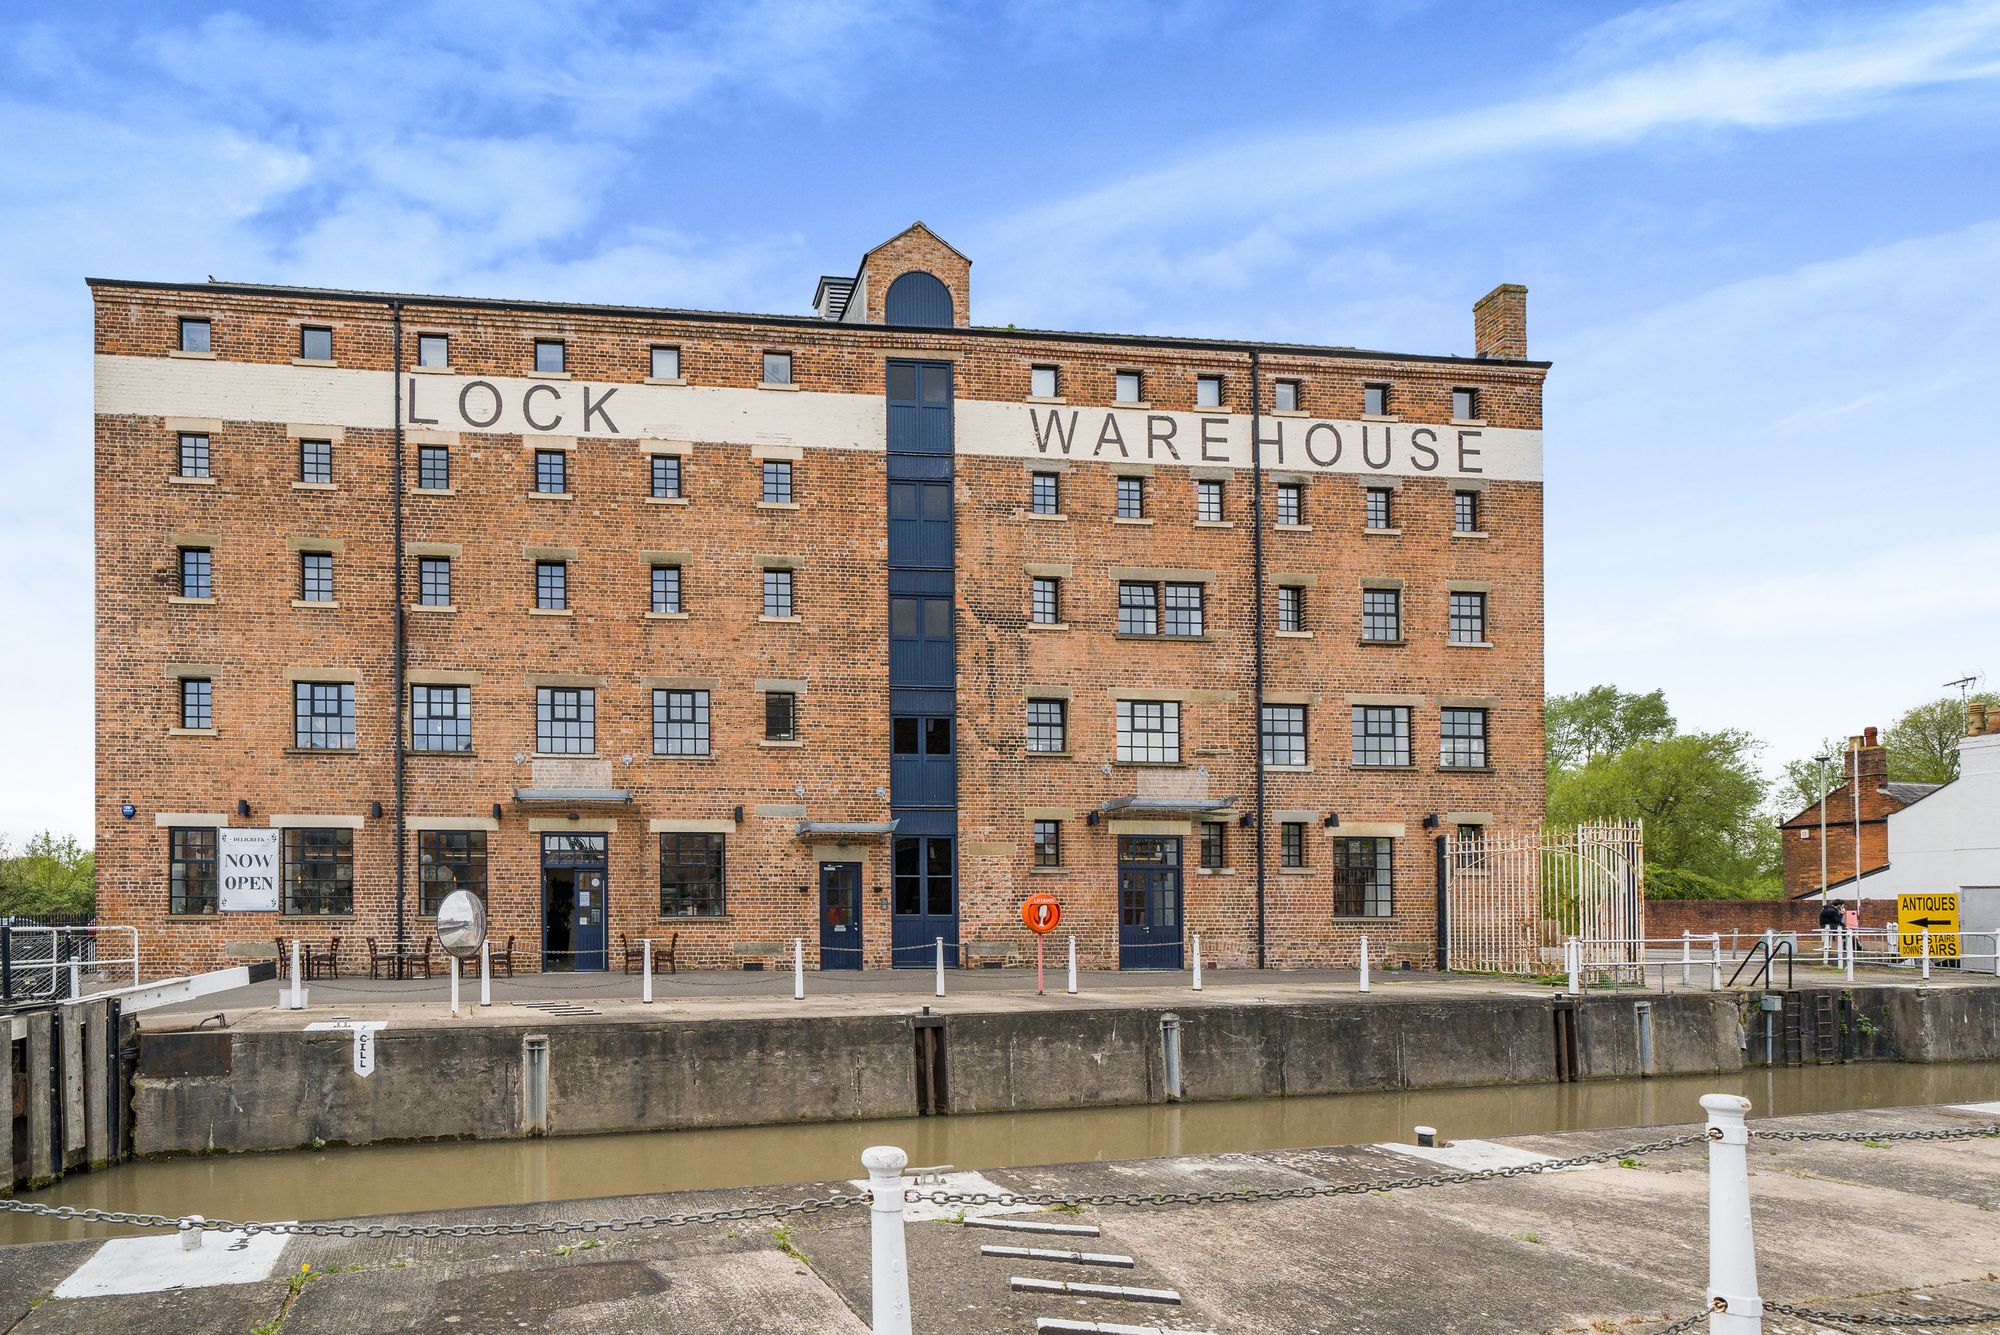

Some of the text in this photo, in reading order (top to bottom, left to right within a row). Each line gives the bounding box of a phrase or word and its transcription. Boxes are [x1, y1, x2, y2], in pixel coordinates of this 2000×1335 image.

[408, 378, 620, 433] LOCK
[1029, 408, 1484, 474] WAREHOUSE
[224, 853, 273, 868] NOW
[224, 876, 274, 890] OPEN
[1902, 897, 1955, 912] ANTIQUES
[1903, 934, 1956, 945] UPSTAIRS
[1903, 943, 1957, 956] DOWNSAIRS
